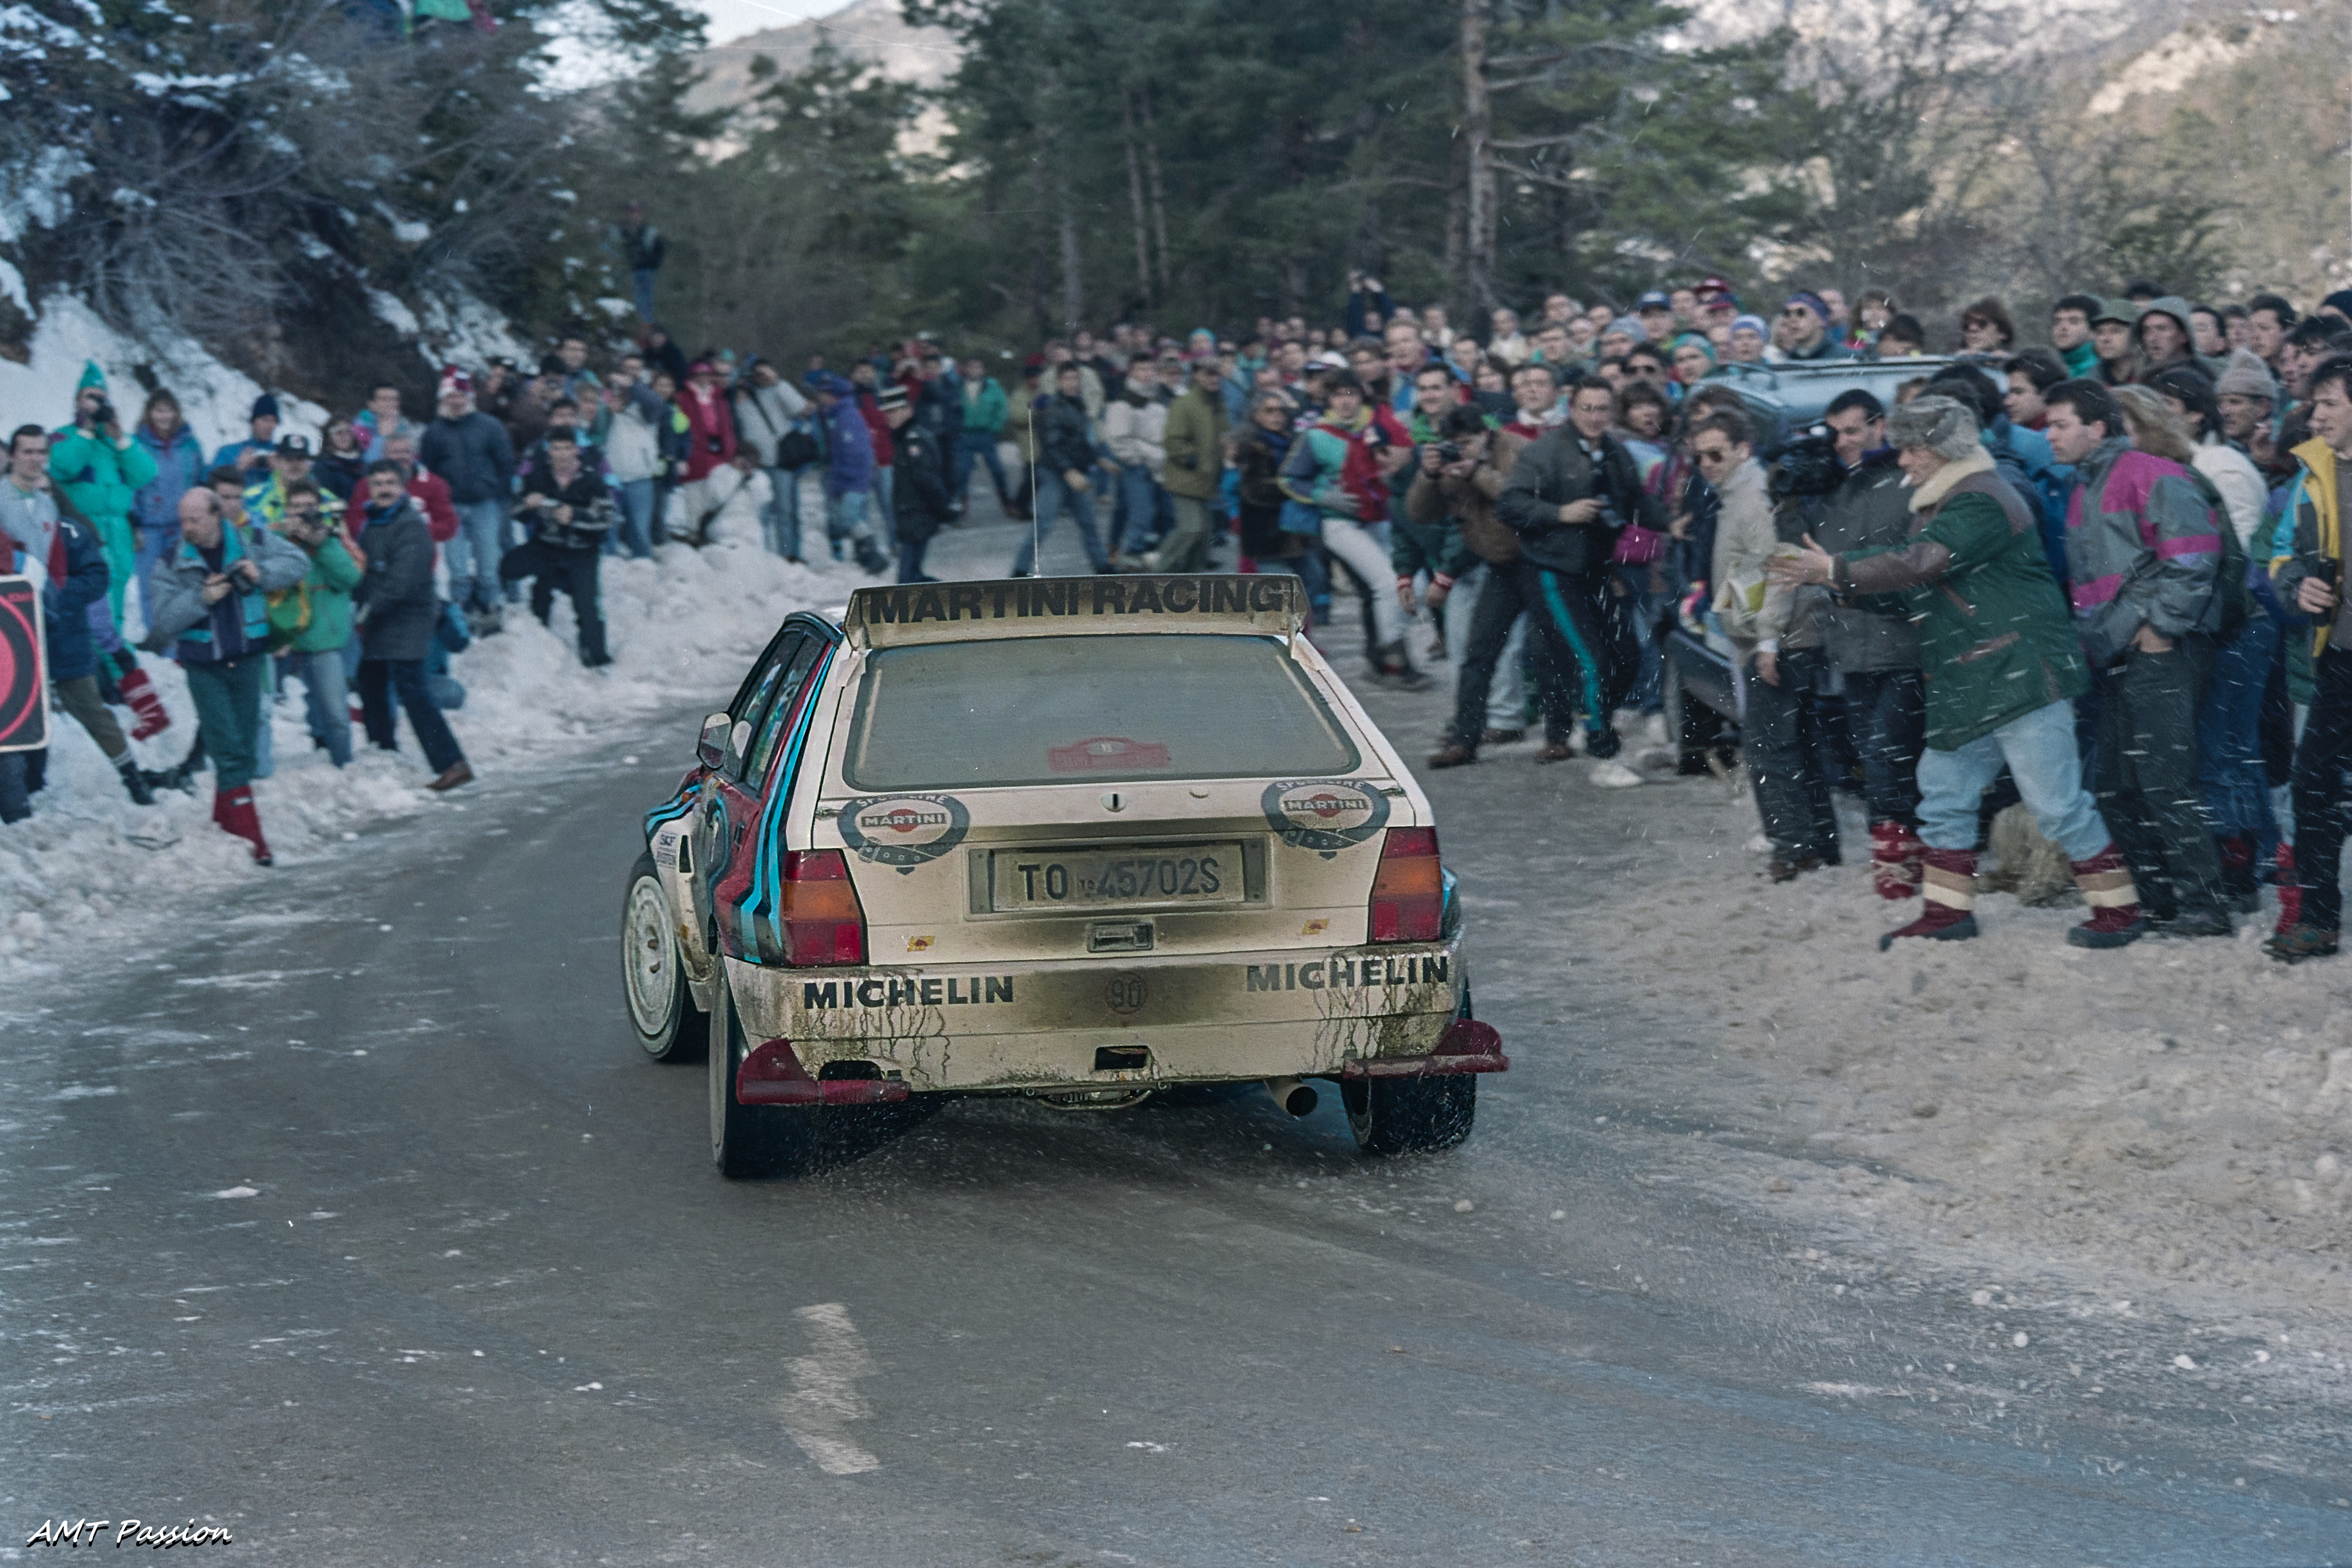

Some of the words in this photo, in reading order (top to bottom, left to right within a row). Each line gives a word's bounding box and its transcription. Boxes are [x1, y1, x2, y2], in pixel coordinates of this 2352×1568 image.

[869, 580, 1080, 624] MARTINI
[1093, 578, 1285, 615] RACING
[864, 813, 944, 826] MARTINI
[1287, 799, 1365, 810] MARTINI
[1017, 864, 1068, 901] TO
[1247, 956, 1449, 992] MICHELIN
[804, 976, 1014, 1009] MICHELIN
